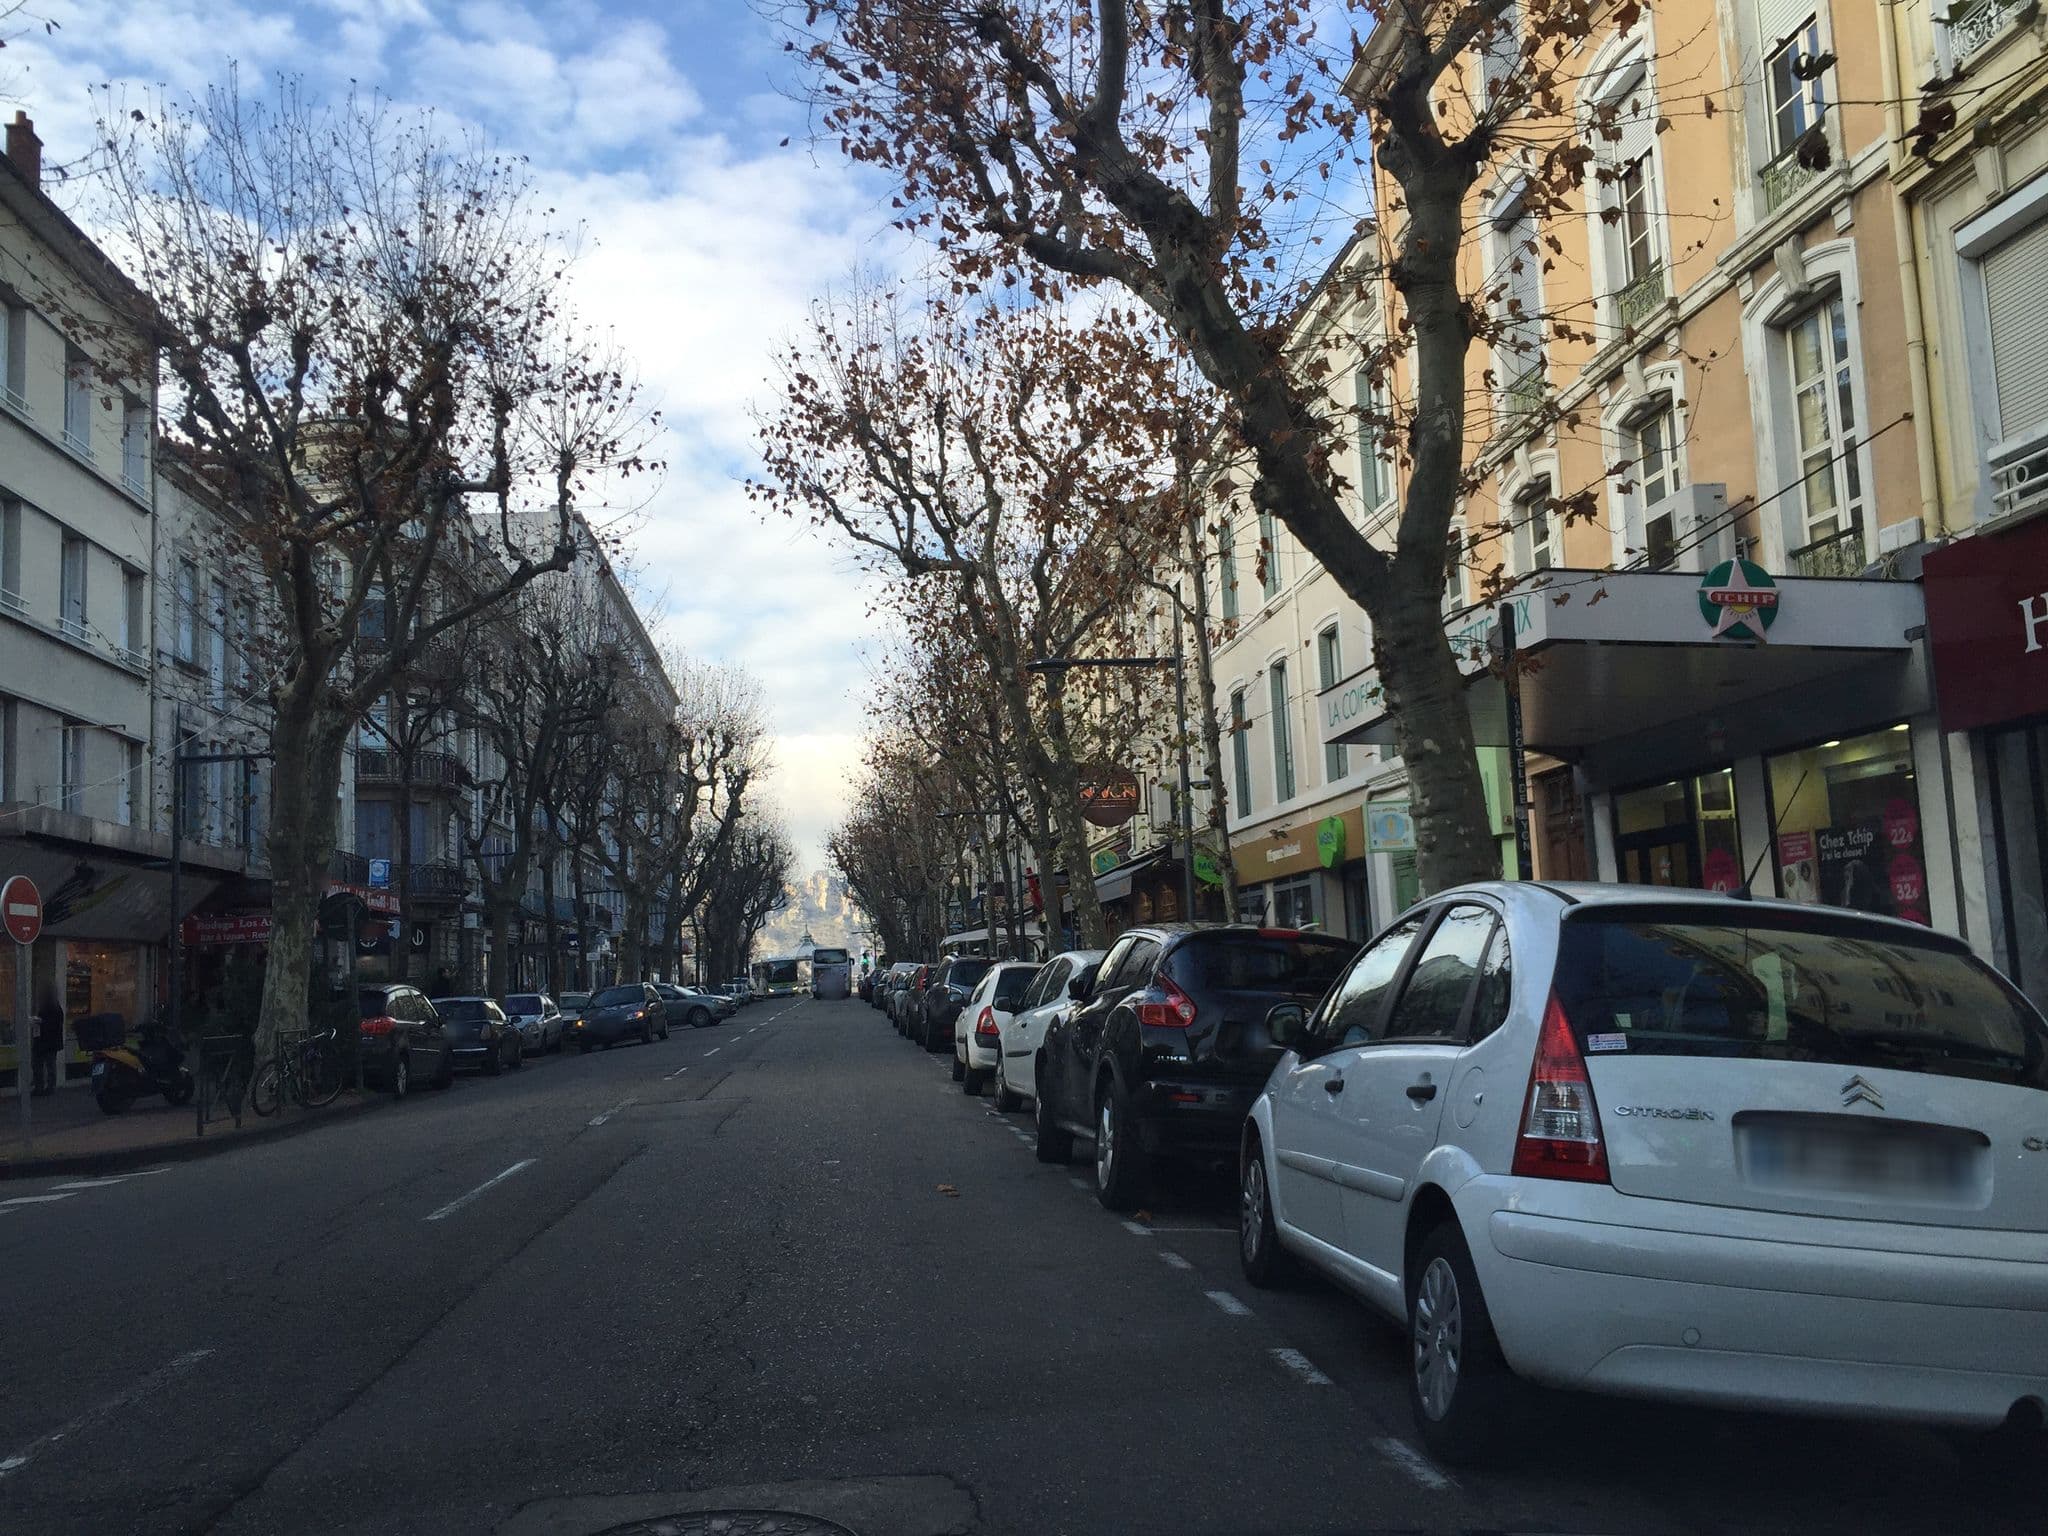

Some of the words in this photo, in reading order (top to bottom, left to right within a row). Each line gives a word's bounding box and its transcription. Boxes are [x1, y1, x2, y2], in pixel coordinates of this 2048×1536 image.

[1716, 592, 1776, 606] TCHIP
[1327, 699, 1341, 727] LA
[1342, 680, 1385, 720] COIFFUR
[1819, 833, 1845, 849] Chez
[1847, 828, 1874, 847] Tchip
[239, 919, 257, 928] Los
[2022, 1136, 2048, 1152] C
